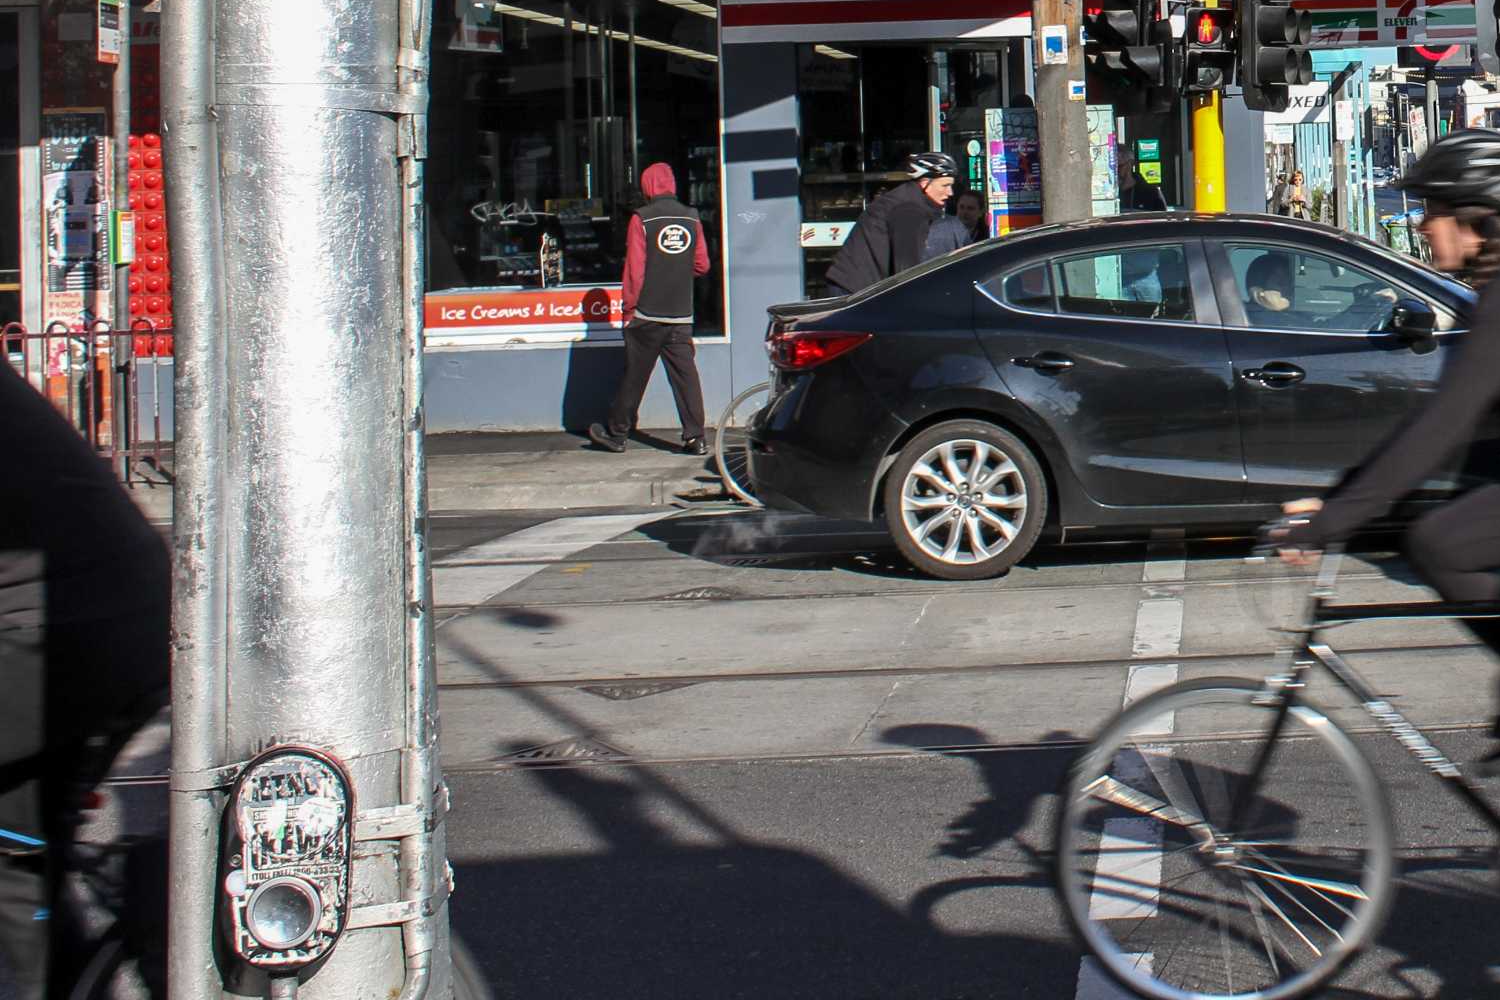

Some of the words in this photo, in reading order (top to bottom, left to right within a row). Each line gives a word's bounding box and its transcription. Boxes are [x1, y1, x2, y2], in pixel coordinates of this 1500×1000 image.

[1287, 95, 1326, 108] IXED
[441, 306, 467, 320] Ice
[471, 304, 530, 320] Creams
[534, 302, 545, 316] &
[550, 301, 585, 316] Iced
[591, 299, 623, 316] Coff
